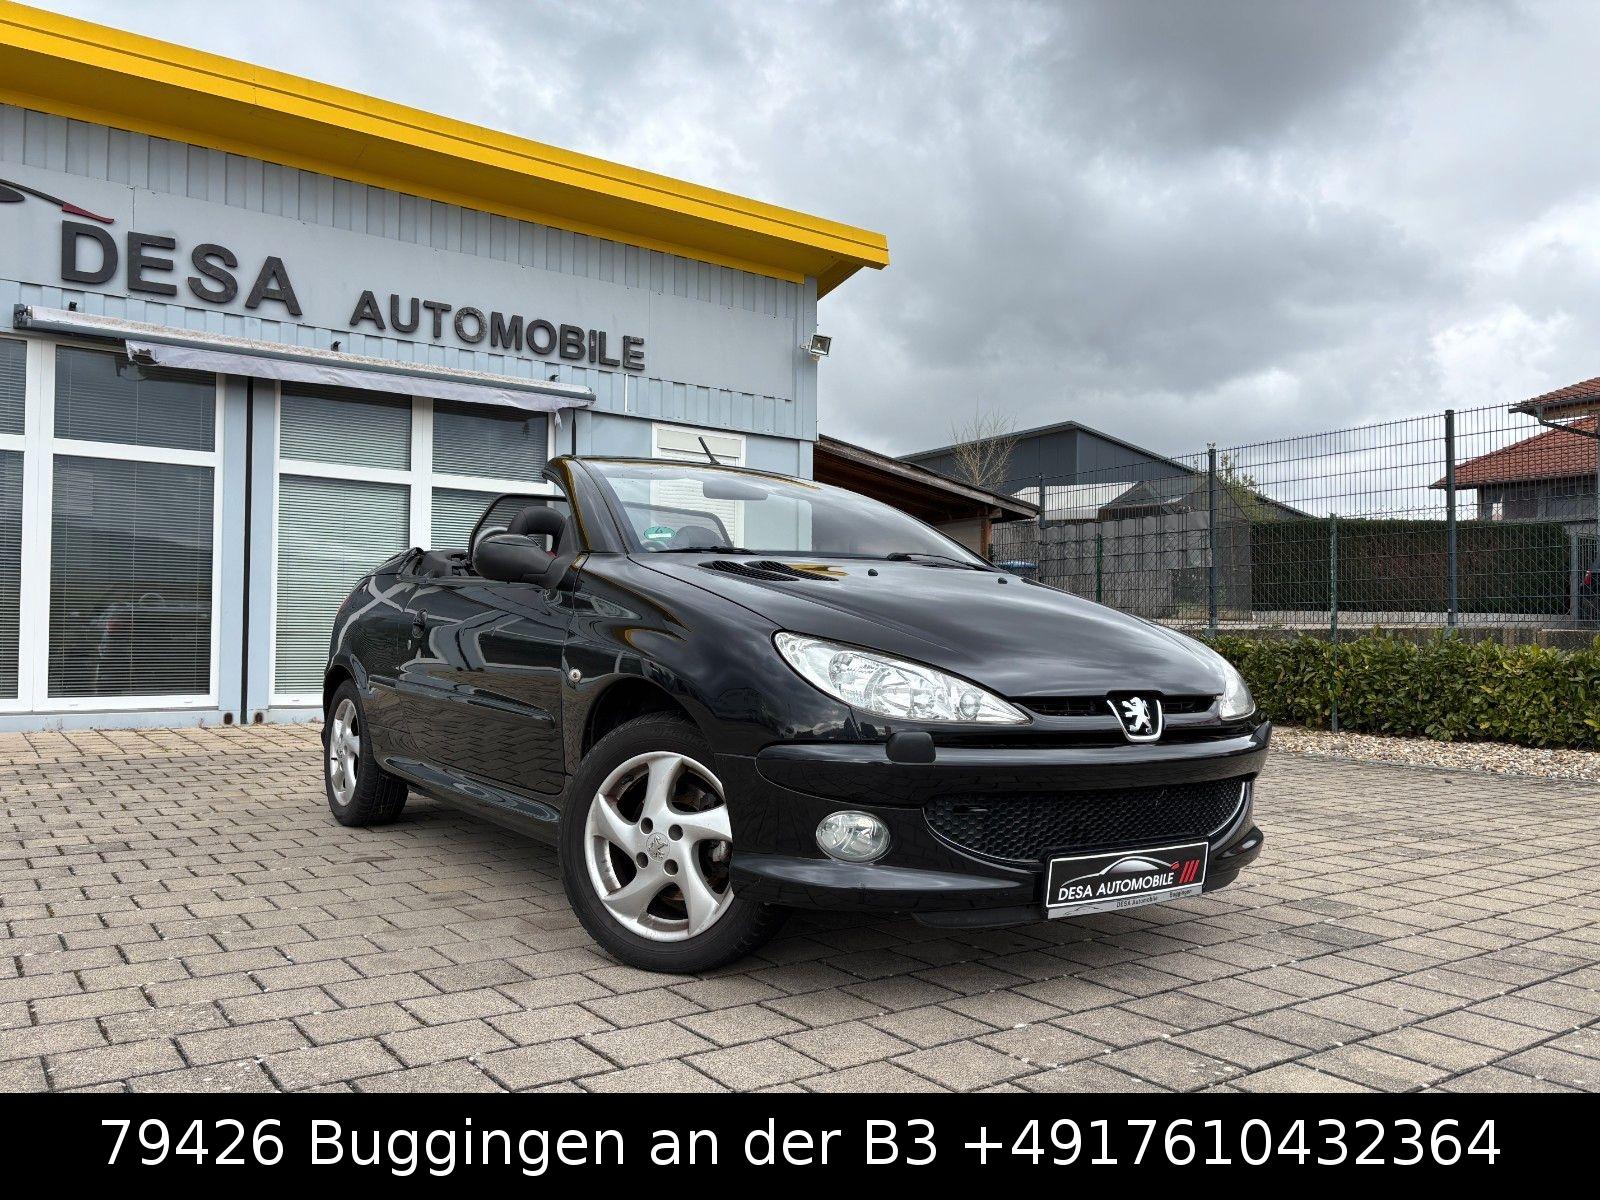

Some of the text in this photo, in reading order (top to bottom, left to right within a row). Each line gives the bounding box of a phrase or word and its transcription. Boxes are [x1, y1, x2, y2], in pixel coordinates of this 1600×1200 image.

[61, 219, 646, 371] DESA AUTOMOBILE
[1058, 872, 1174, 901] DESA AUTOMOBILE
[1116, 899, 1131, 908] DESA
